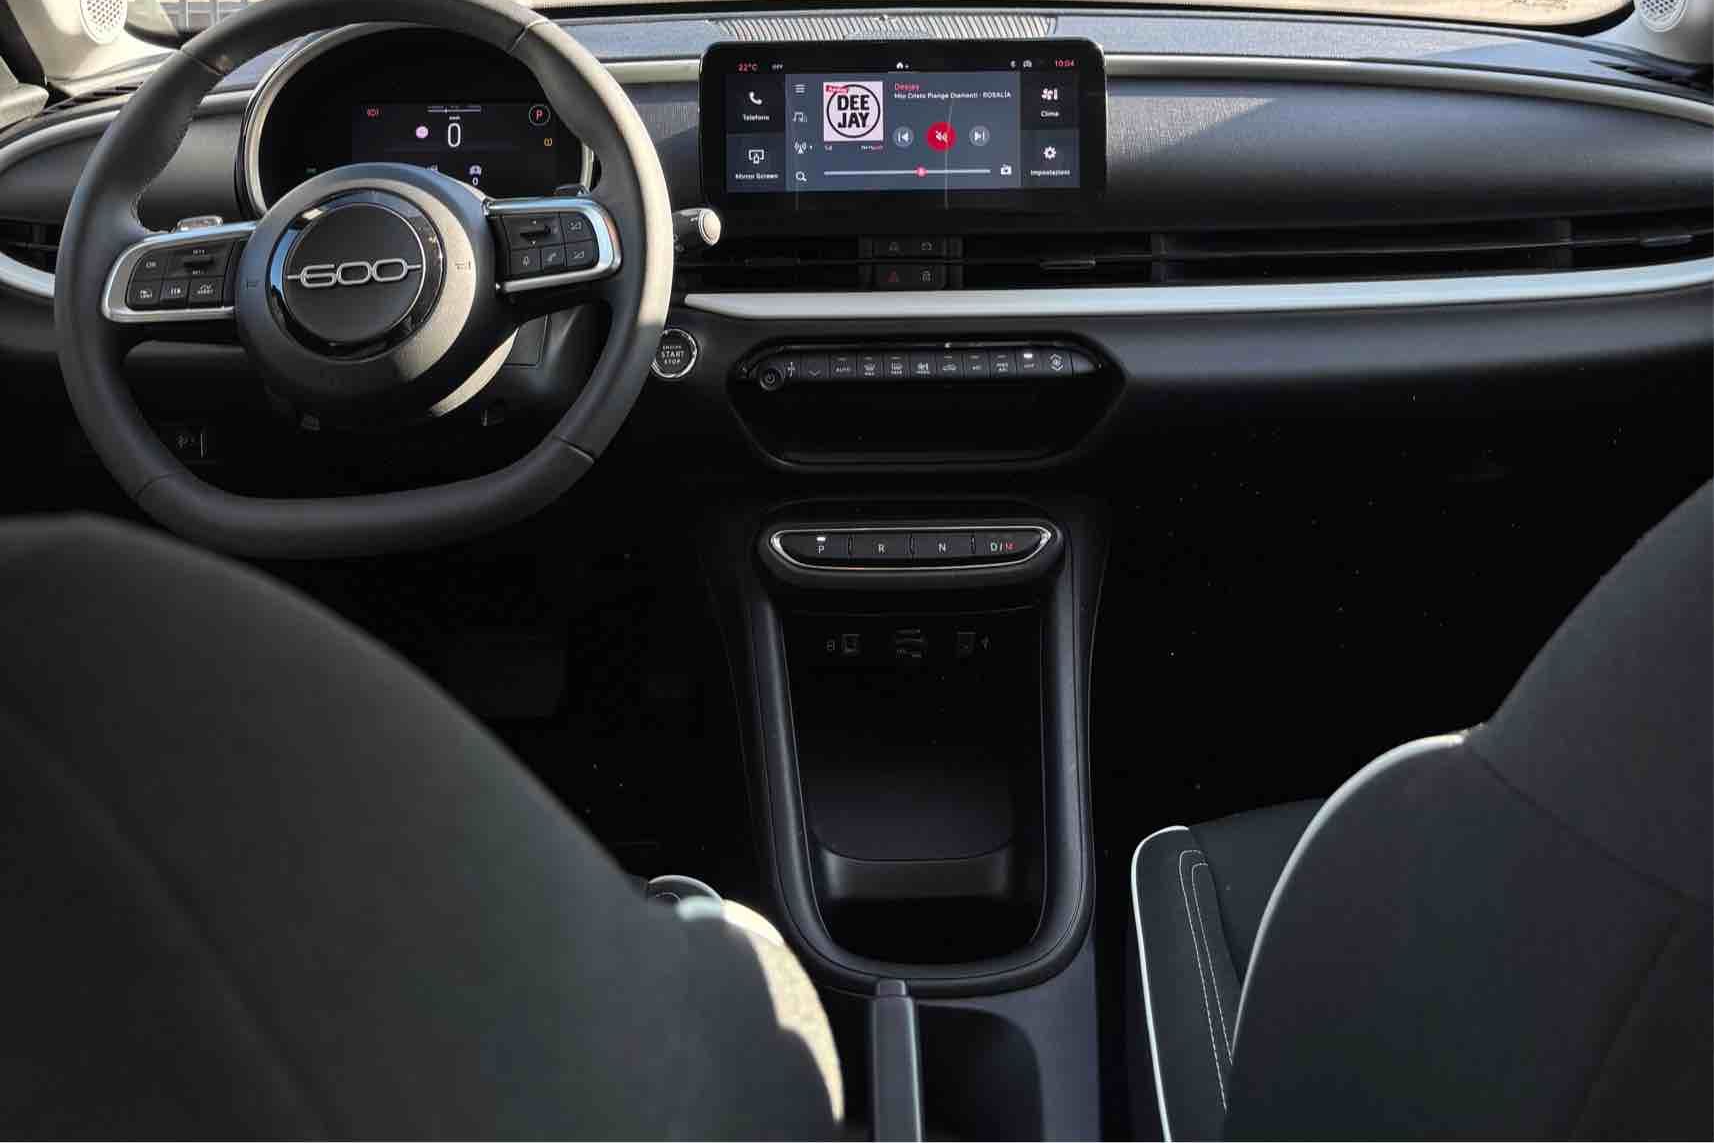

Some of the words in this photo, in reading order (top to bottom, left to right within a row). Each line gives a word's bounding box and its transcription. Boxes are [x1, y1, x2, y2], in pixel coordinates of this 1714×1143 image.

[837, 94, 870, 110] DEE
[535, 109, 543, 121] P
[837, 112, 870, 128] JAY
[300, 258, 408, 288] 600
[661, 350, 685, 358] START
[818, 545, 825, 555] P
[878, 543, 886, 553] R
[938, 543, 947, 552] N
